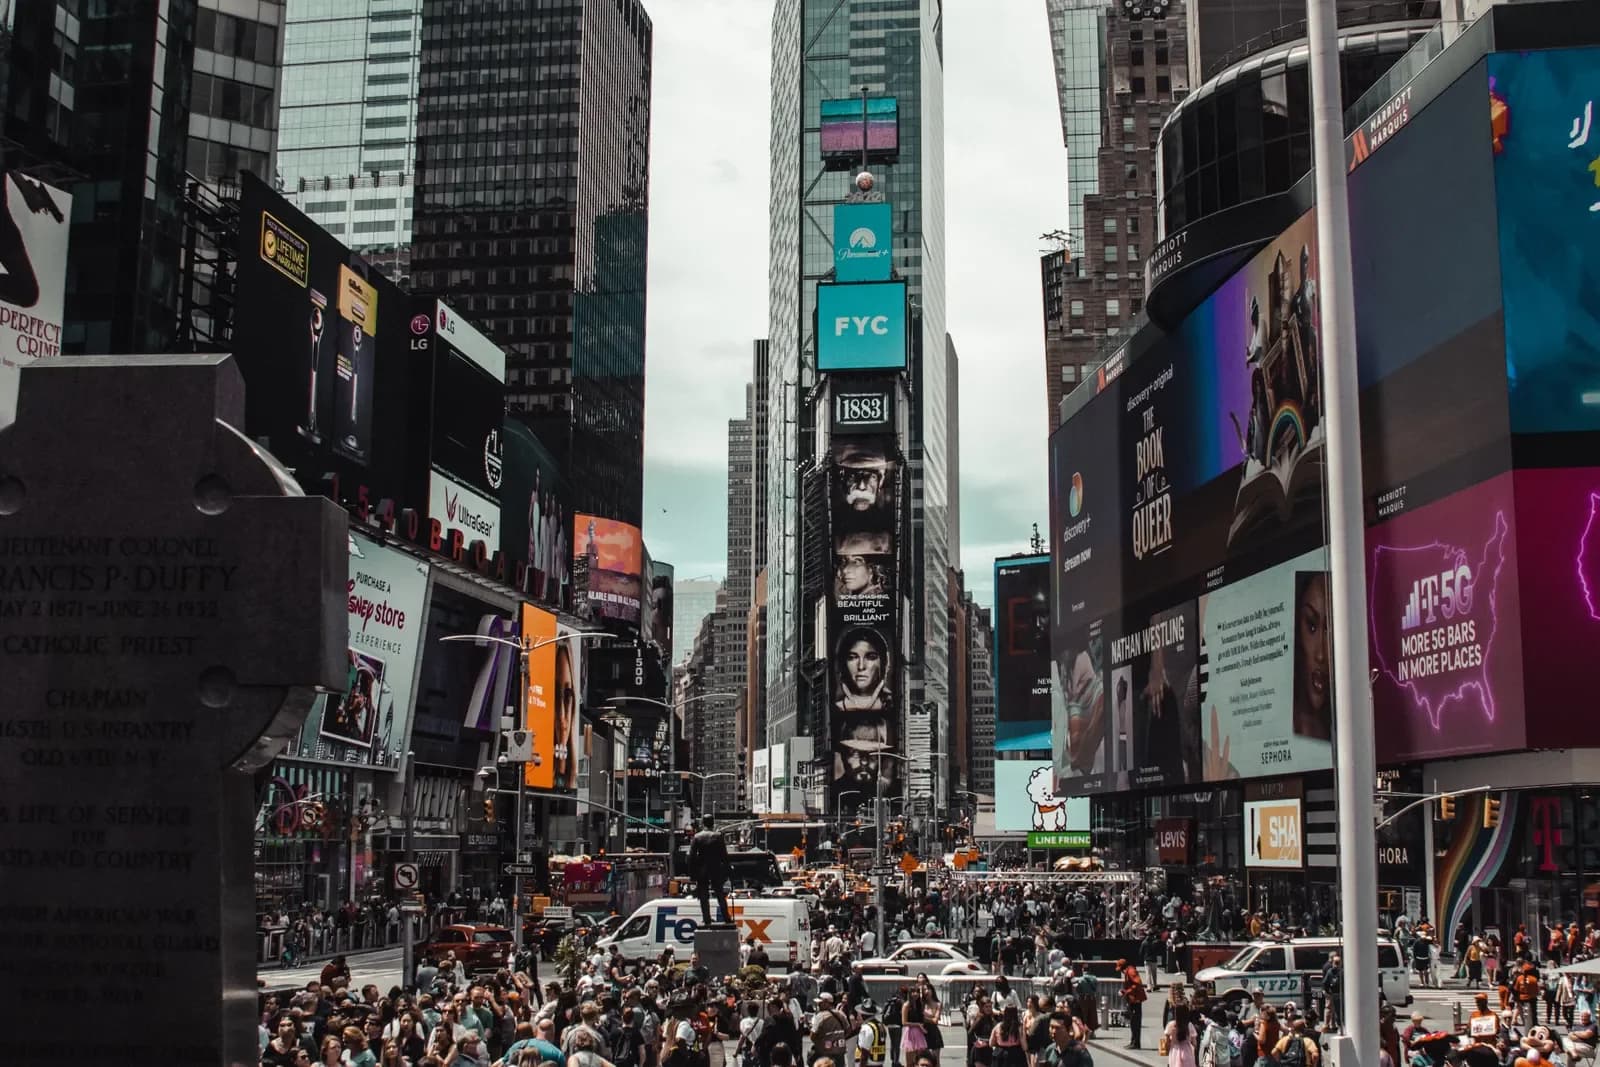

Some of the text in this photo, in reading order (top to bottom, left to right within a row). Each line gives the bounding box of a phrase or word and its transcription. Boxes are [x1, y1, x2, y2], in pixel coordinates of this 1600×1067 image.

[1370, 86, 1412, 133] MARRIOTT
[1371, 110, 1408, 150] MARQUIS
[277, 237, 305, 270] LIFETIME
[1150, 231, 1188, 264] MARRIOTT
[1151, 251, 1182, 281] MARQUIS
[0, 306, 61, 344] PERFECT
[447, 318, 454, 334] LG
[835, 316, 888, 336] FYC
[411, 339, 428, 350] LG
[1127, 363, 1173, 412] discovery+ original
[842, 398, 880, 420] 1883
[1142, 405, 1154, 433] THE
[1136, 426, 1164, 485] BOOK
[1147, 474, 1155, 500] OF
[1377, 486, 1407, 505] MARRIOTT
[458, 504, 492, 538] UltraGear
[1378, 499, 1405, 517] MARQUIS
[1132, 493, 1172, 561] QUEER
[119, 536, 217, 557] COLONEL
[136, 565, 237, 592] DUFFY
[356, 571, 392, 594] PURCHASE A
[1441, 565, 1473, 619] 5G
[375, 600, 405, 630] store
[4, 634, 198, 656] CATHOLIC PRIEST
[355, 632, 401, 655] EXPERIENCE
[1111, 632, 1141, 665] NATHAN
[1142, 615, 1185, 654] WESTLING
[1401, 620, 1476, 657] MORE 5G BARS
[634, 648, 643, 686] 1500
[1398, 643, 1482, 681] IN MORE PLACES
[1033, 687, 1049, 697] NOW
[1261, 750, 1292, 765] SEPHORA
[1036, 835, 1056, 845] LINE
[1379, 847, 1408, 865] HORA
[1259, 979, 1298, 991] NYPD
